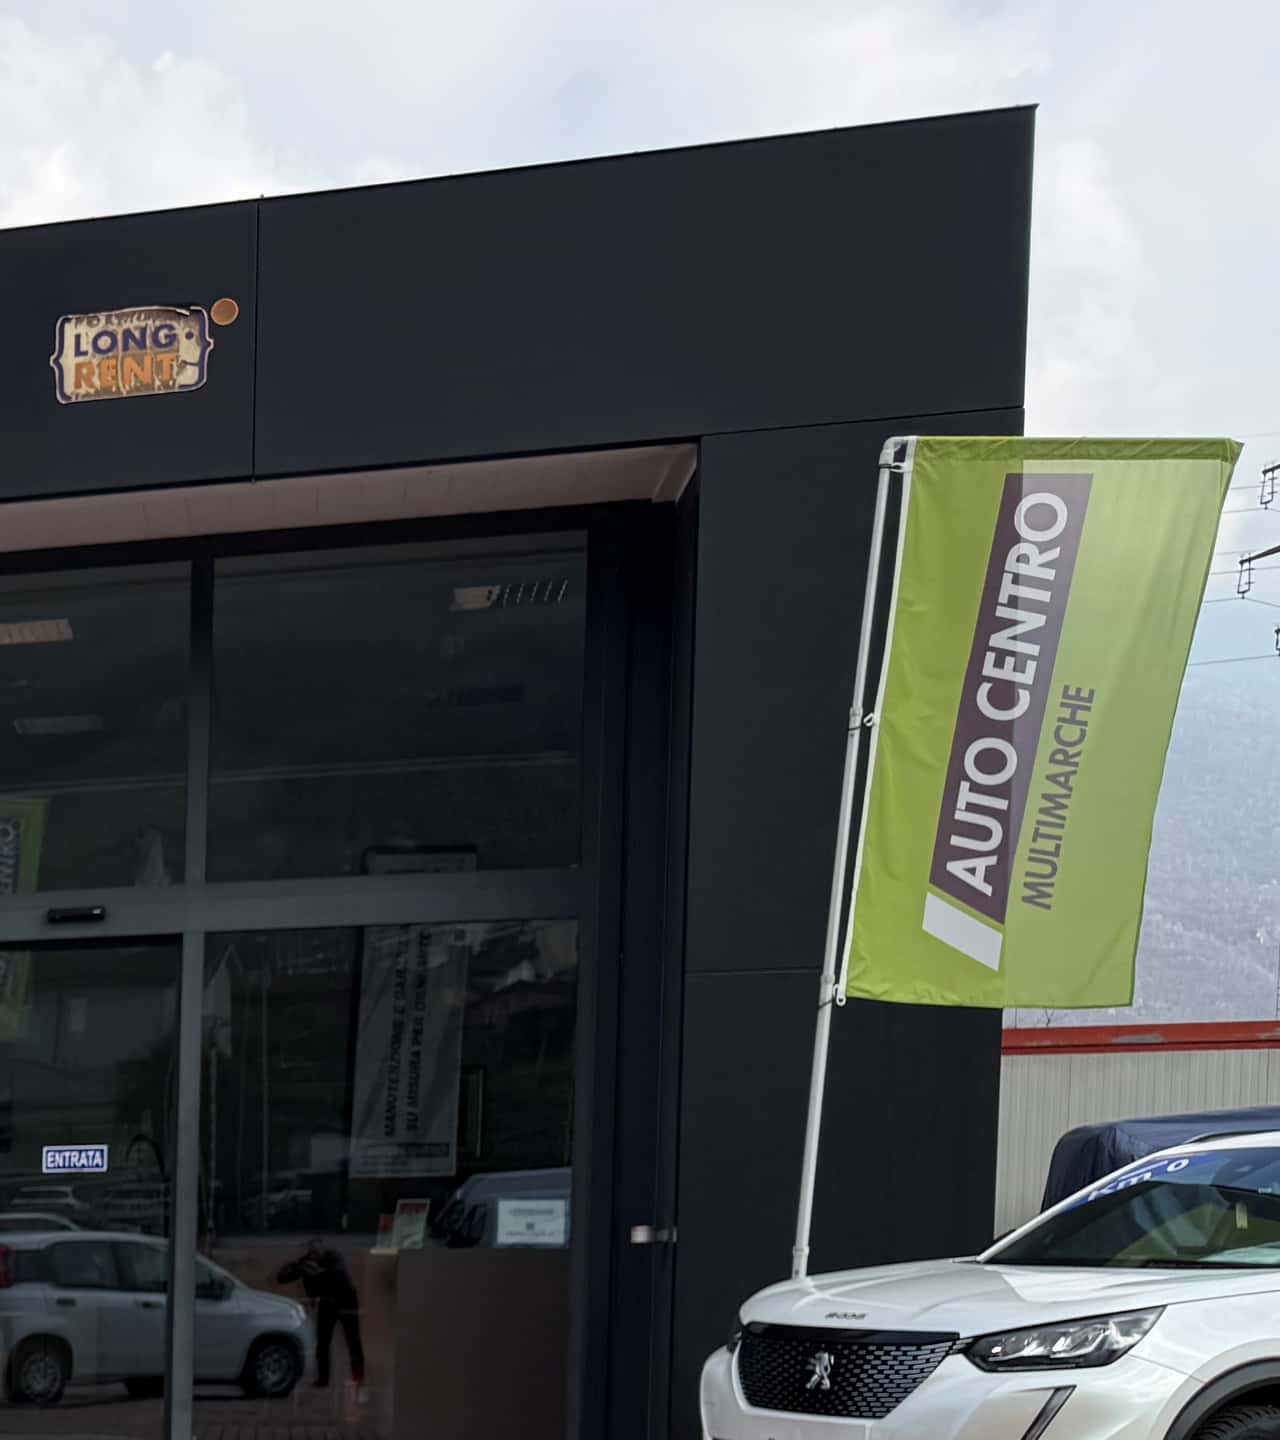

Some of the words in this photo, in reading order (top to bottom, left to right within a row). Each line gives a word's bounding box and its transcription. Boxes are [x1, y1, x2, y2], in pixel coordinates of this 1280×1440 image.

[74, 323, 177, 357] LONG
[74, 353, 178, 390] RENT
[975, 492, 1068, 721] CENTRO
[945, 736, 1018, 896] AUTO
[1021, 684, 1096, 911] MULTIMARCHE
[47, 1150, 103, 1169] ENTRATA
